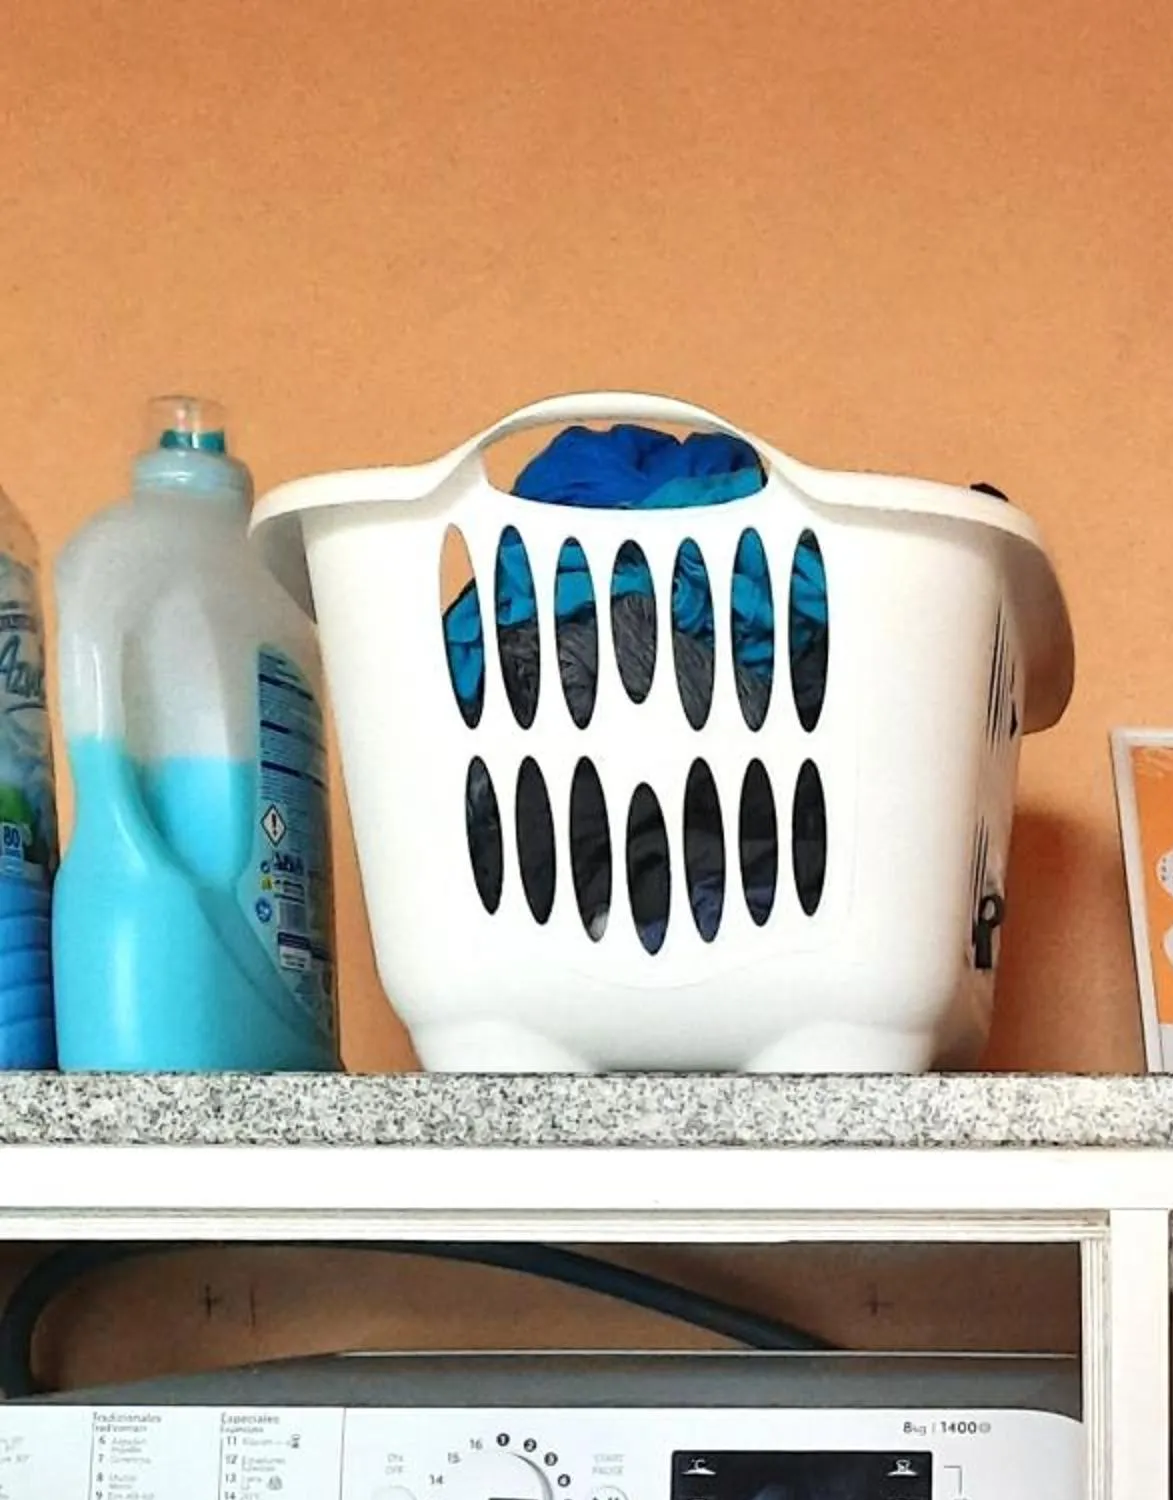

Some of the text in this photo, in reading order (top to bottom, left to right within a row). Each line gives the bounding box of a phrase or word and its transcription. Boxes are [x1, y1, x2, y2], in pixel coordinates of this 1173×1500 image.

[940, 1421, 977, 1435] 1400
[469, 1438, 483, 1450] 16
[429, 1474, 443, 1486] 14
